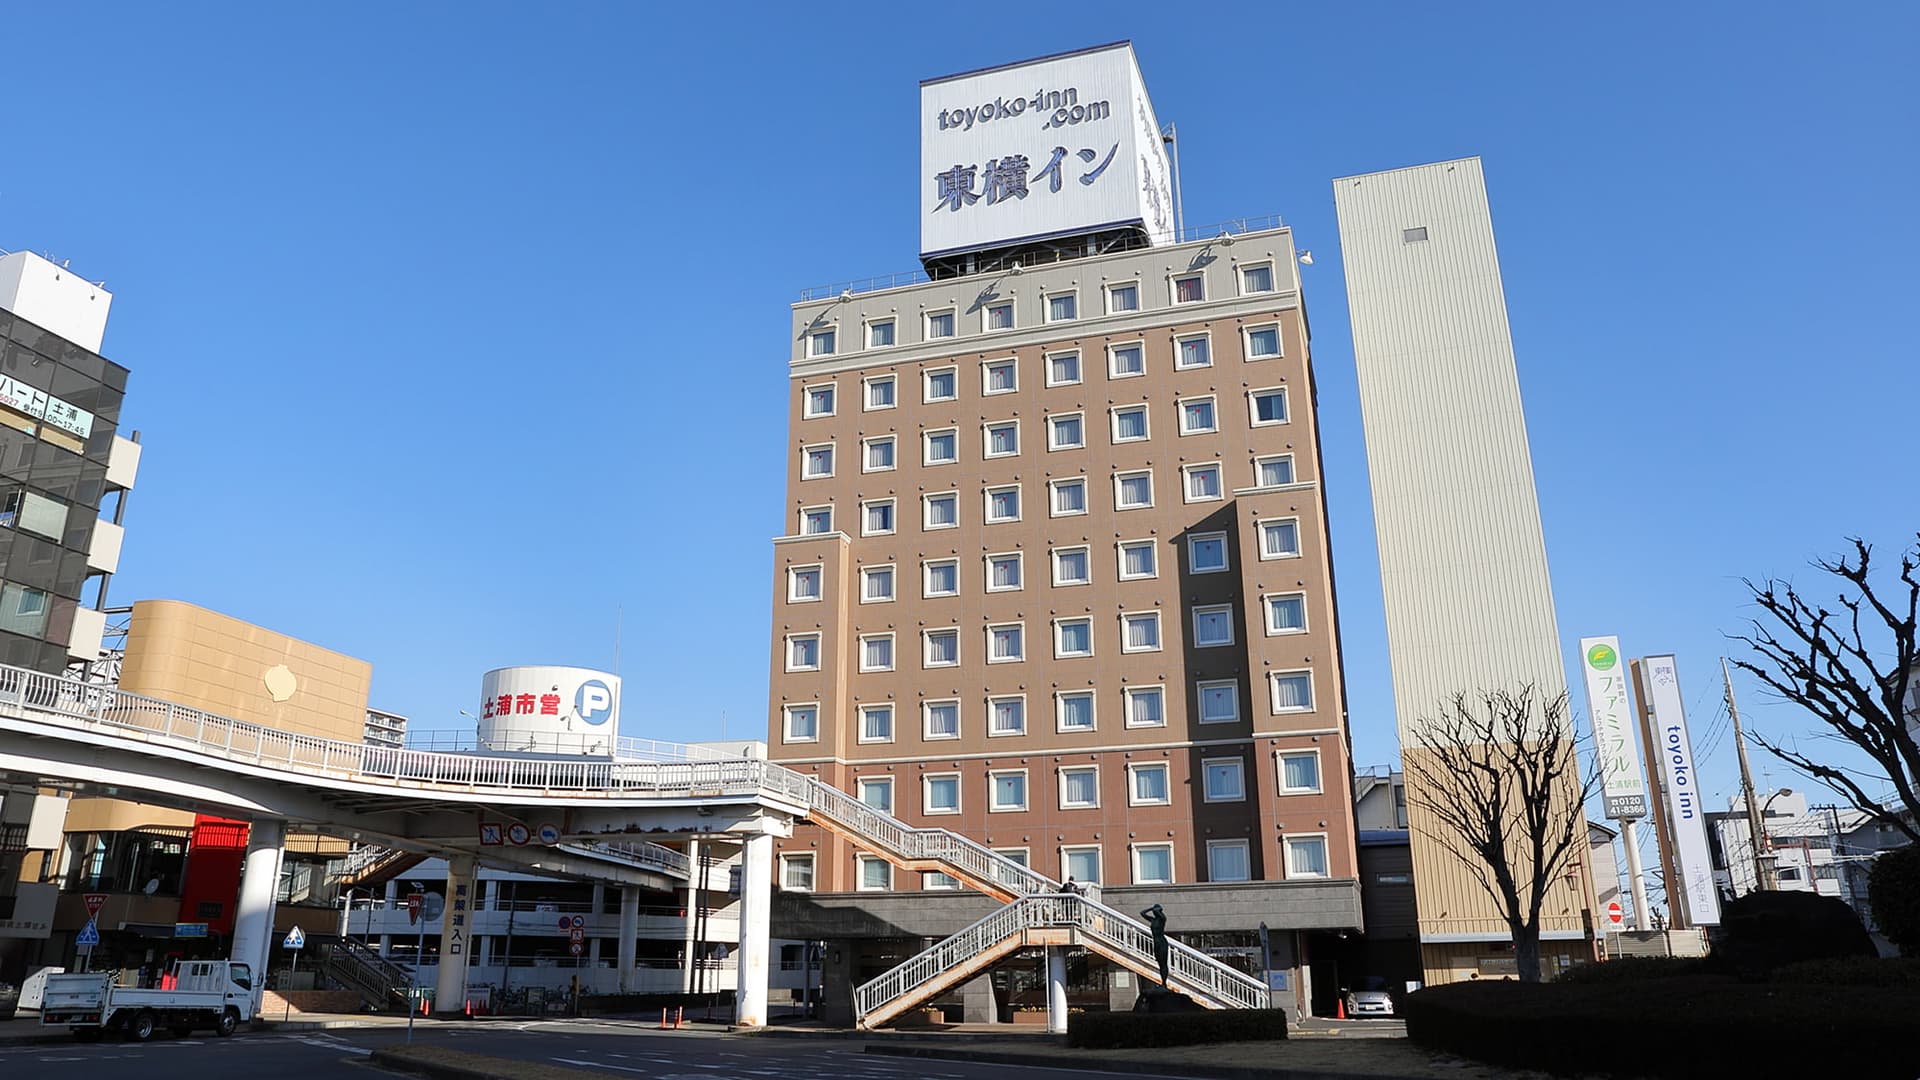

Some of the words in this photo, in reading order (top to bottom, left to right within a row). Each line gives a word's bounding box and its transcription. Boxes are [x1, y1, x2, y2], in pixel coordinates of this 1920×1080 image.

[937, 87, 1078, 131] toyoko-inn
[1042, 100, 1110, 130] .com
[931, 139, 1120, 214] 東横イン
[483, 693, 561, 720] 土浦市営
[582, 684, 610, 717] P
[1599, 676, 1630, 772] ファミラル
[1667, 725, 1689, 786] toyoko
[1679, 792, 1694, 819] inn
[1619, 796, 1641, 806] 0120
